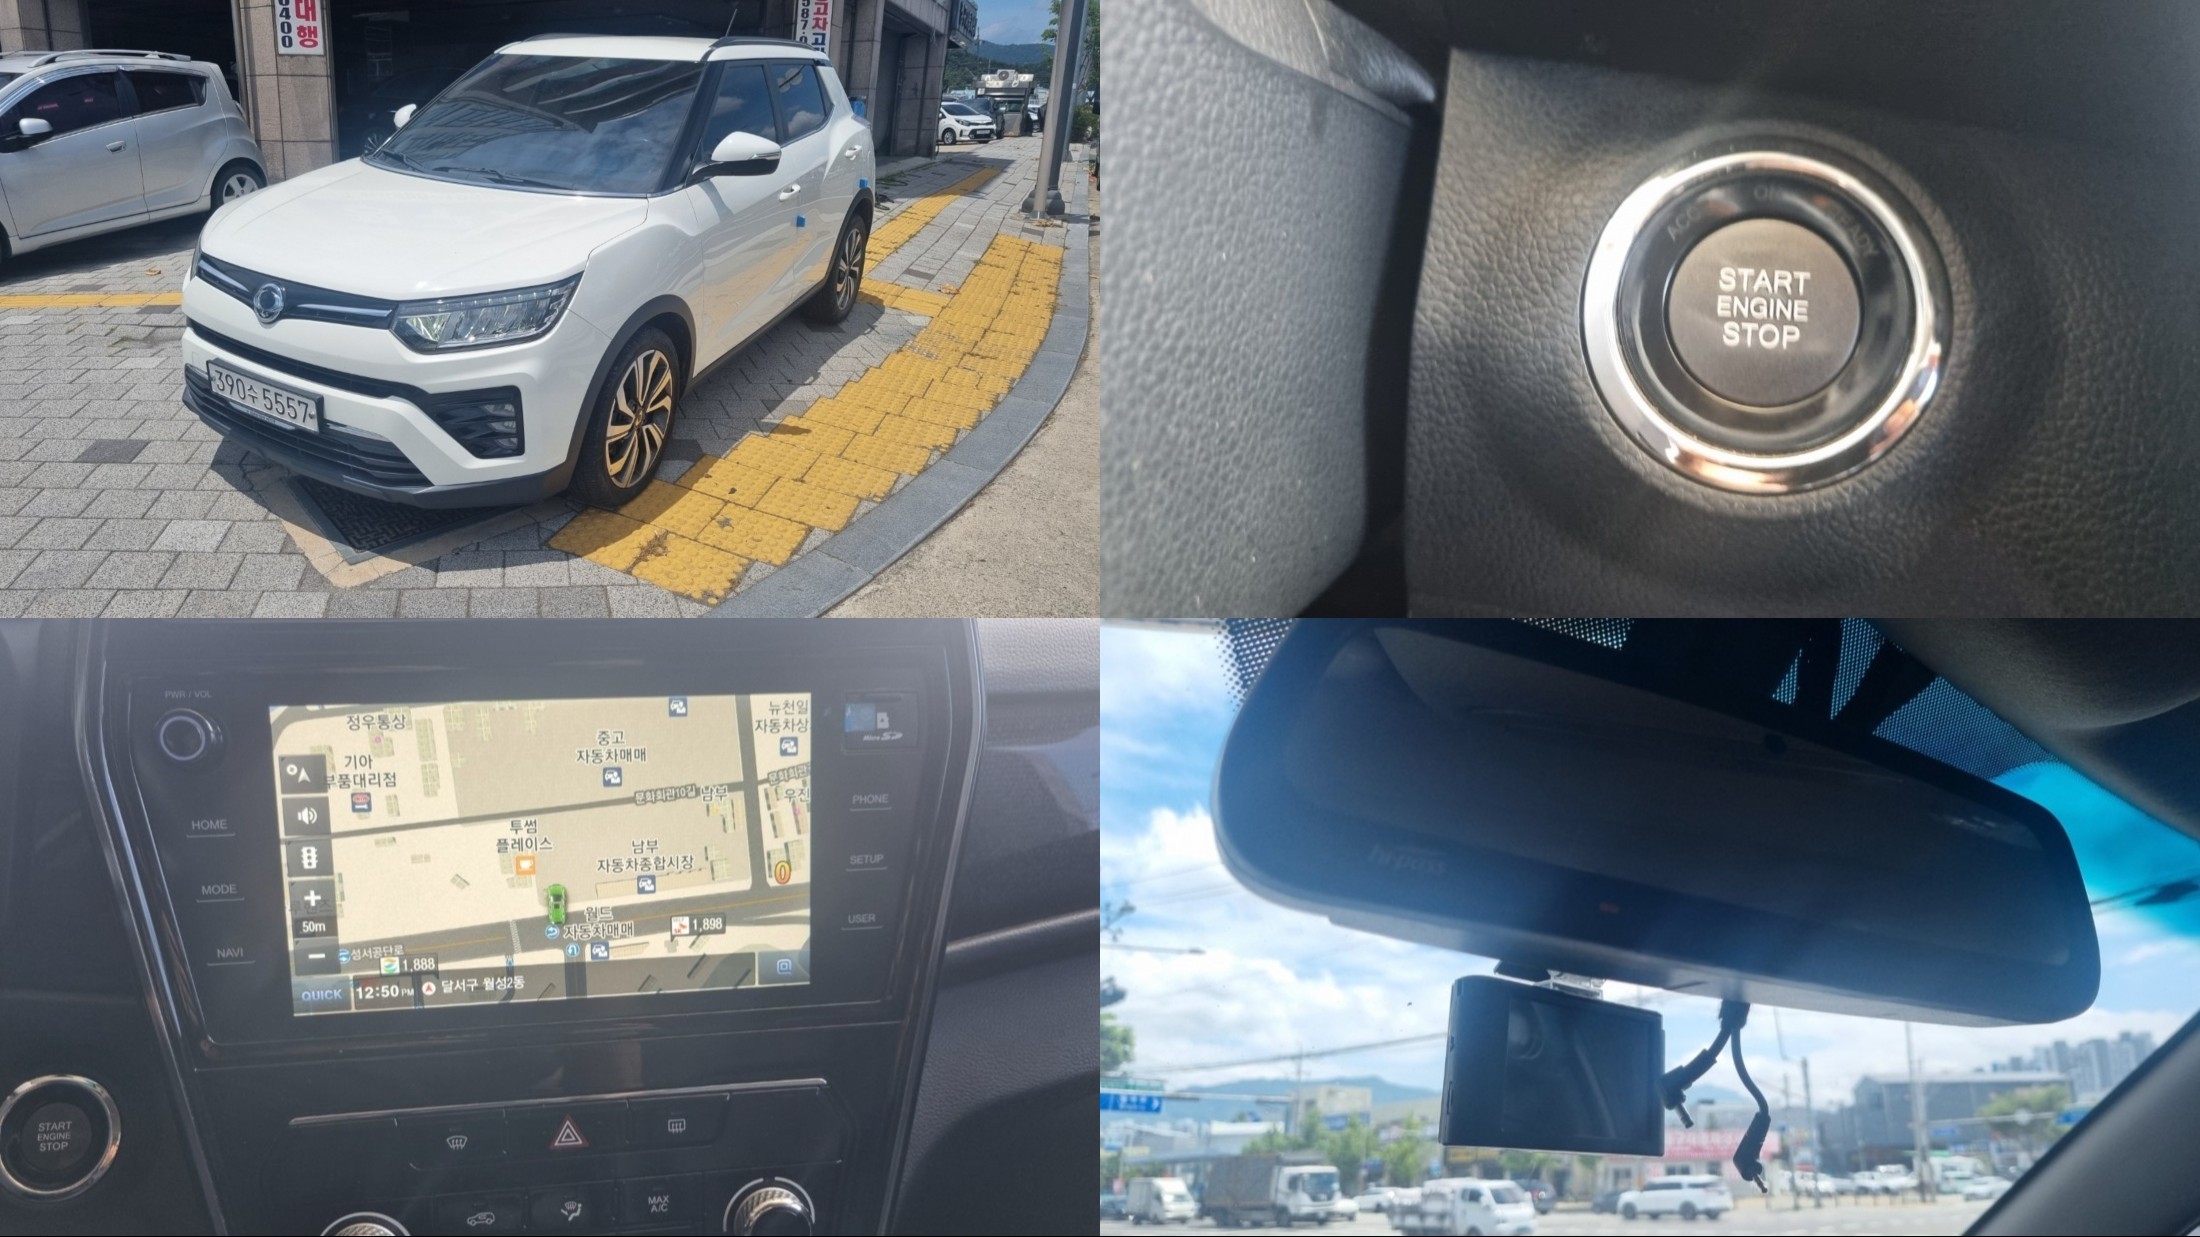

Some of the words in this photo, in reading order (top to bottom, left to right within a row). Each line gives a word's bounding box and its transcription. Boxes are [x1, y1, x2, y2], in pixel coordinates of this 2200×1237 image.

[295, 0, 318, 48] 대행
[1718, 267, 1811, 295] START
[1716, 295, 1809, 322] ENGINE
[1722, 322, 1801, 350] STOP
[215, 370, 257, 404] 390수
[262, 388, 308, 423] 5557
[165, 690, 186, 699] PWR
[194, 690, 213, 699] VOL
[346, 714, 406, 731] 정우통상
[755, 718, 809, 734] 자동차상
[597, 730, 625, 746] 중고
[344, 754, 373, 770] 기아
[576, 747, 647, 763] 자동차매매
[701, 786, 728, 801] 남부
[852, 794, 889, 804] PHONE
[192, 819, 228, 831] HOME
[510, 820, 537, 835] 투썸
[496, 837, 553, 854] 플레이스
[631, 840, 659, 855] 남부
[597, 855, 694, 873] 자동차종합시장
[850, 854, 884, 865] SETUP
[201, 884, 238, 895] MODE
[584, 906, 613, 922] 월드
[848, 913, 876, 924] USER
[302, 920, 327, 933] 50m
[563, 923, 634, 939] 자동차매매
[692, 917, 723, 933] 1,898
[217, 947, 244, 959] NAVI
[402, 958, 436, 973] 1,888
[441, 978, 479, 994] 달서구
[482, 975, 525, 991] 월성2동
[301, 988, 343, 1001] QUICK
[356, 985, 400, 1000] 12:50
[401, 988, 415, 998] PM
[38, 1121, 73, 1132] START
[37, 1131, 71, 1142] ENGINE
[39, 1141, 69, 1152] STOP
[648, 1195, 669, 1205] MAX
[651, 1204, 668, 1213] A/C
